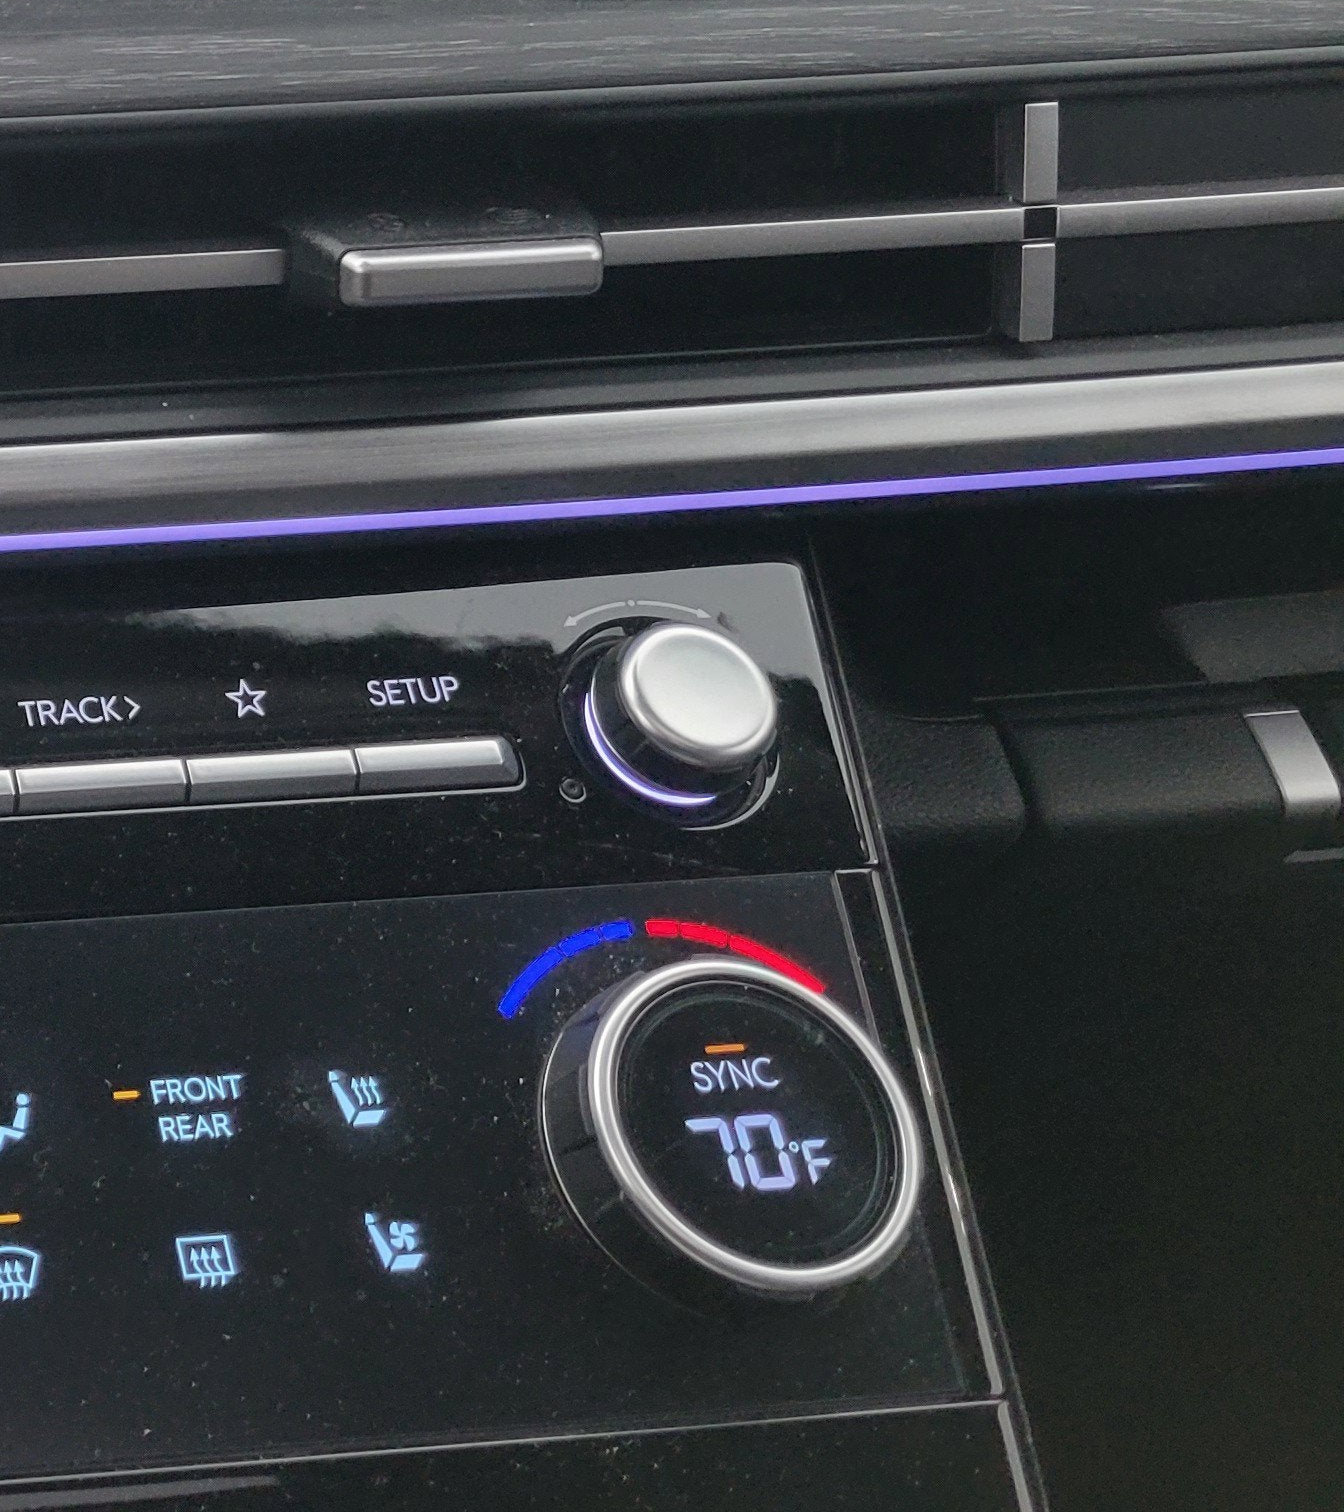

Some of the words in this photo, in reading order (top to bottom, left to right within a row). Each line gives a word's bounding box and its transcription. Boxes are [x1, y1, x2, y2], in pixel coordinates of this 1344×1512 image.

[365, 674, 461, 707] SETUP
[148, 1073, 244, 1105] FRONT
[689, 1057, 781, 1094] SYNC
[157, 1112, 235, 1143] REAR
